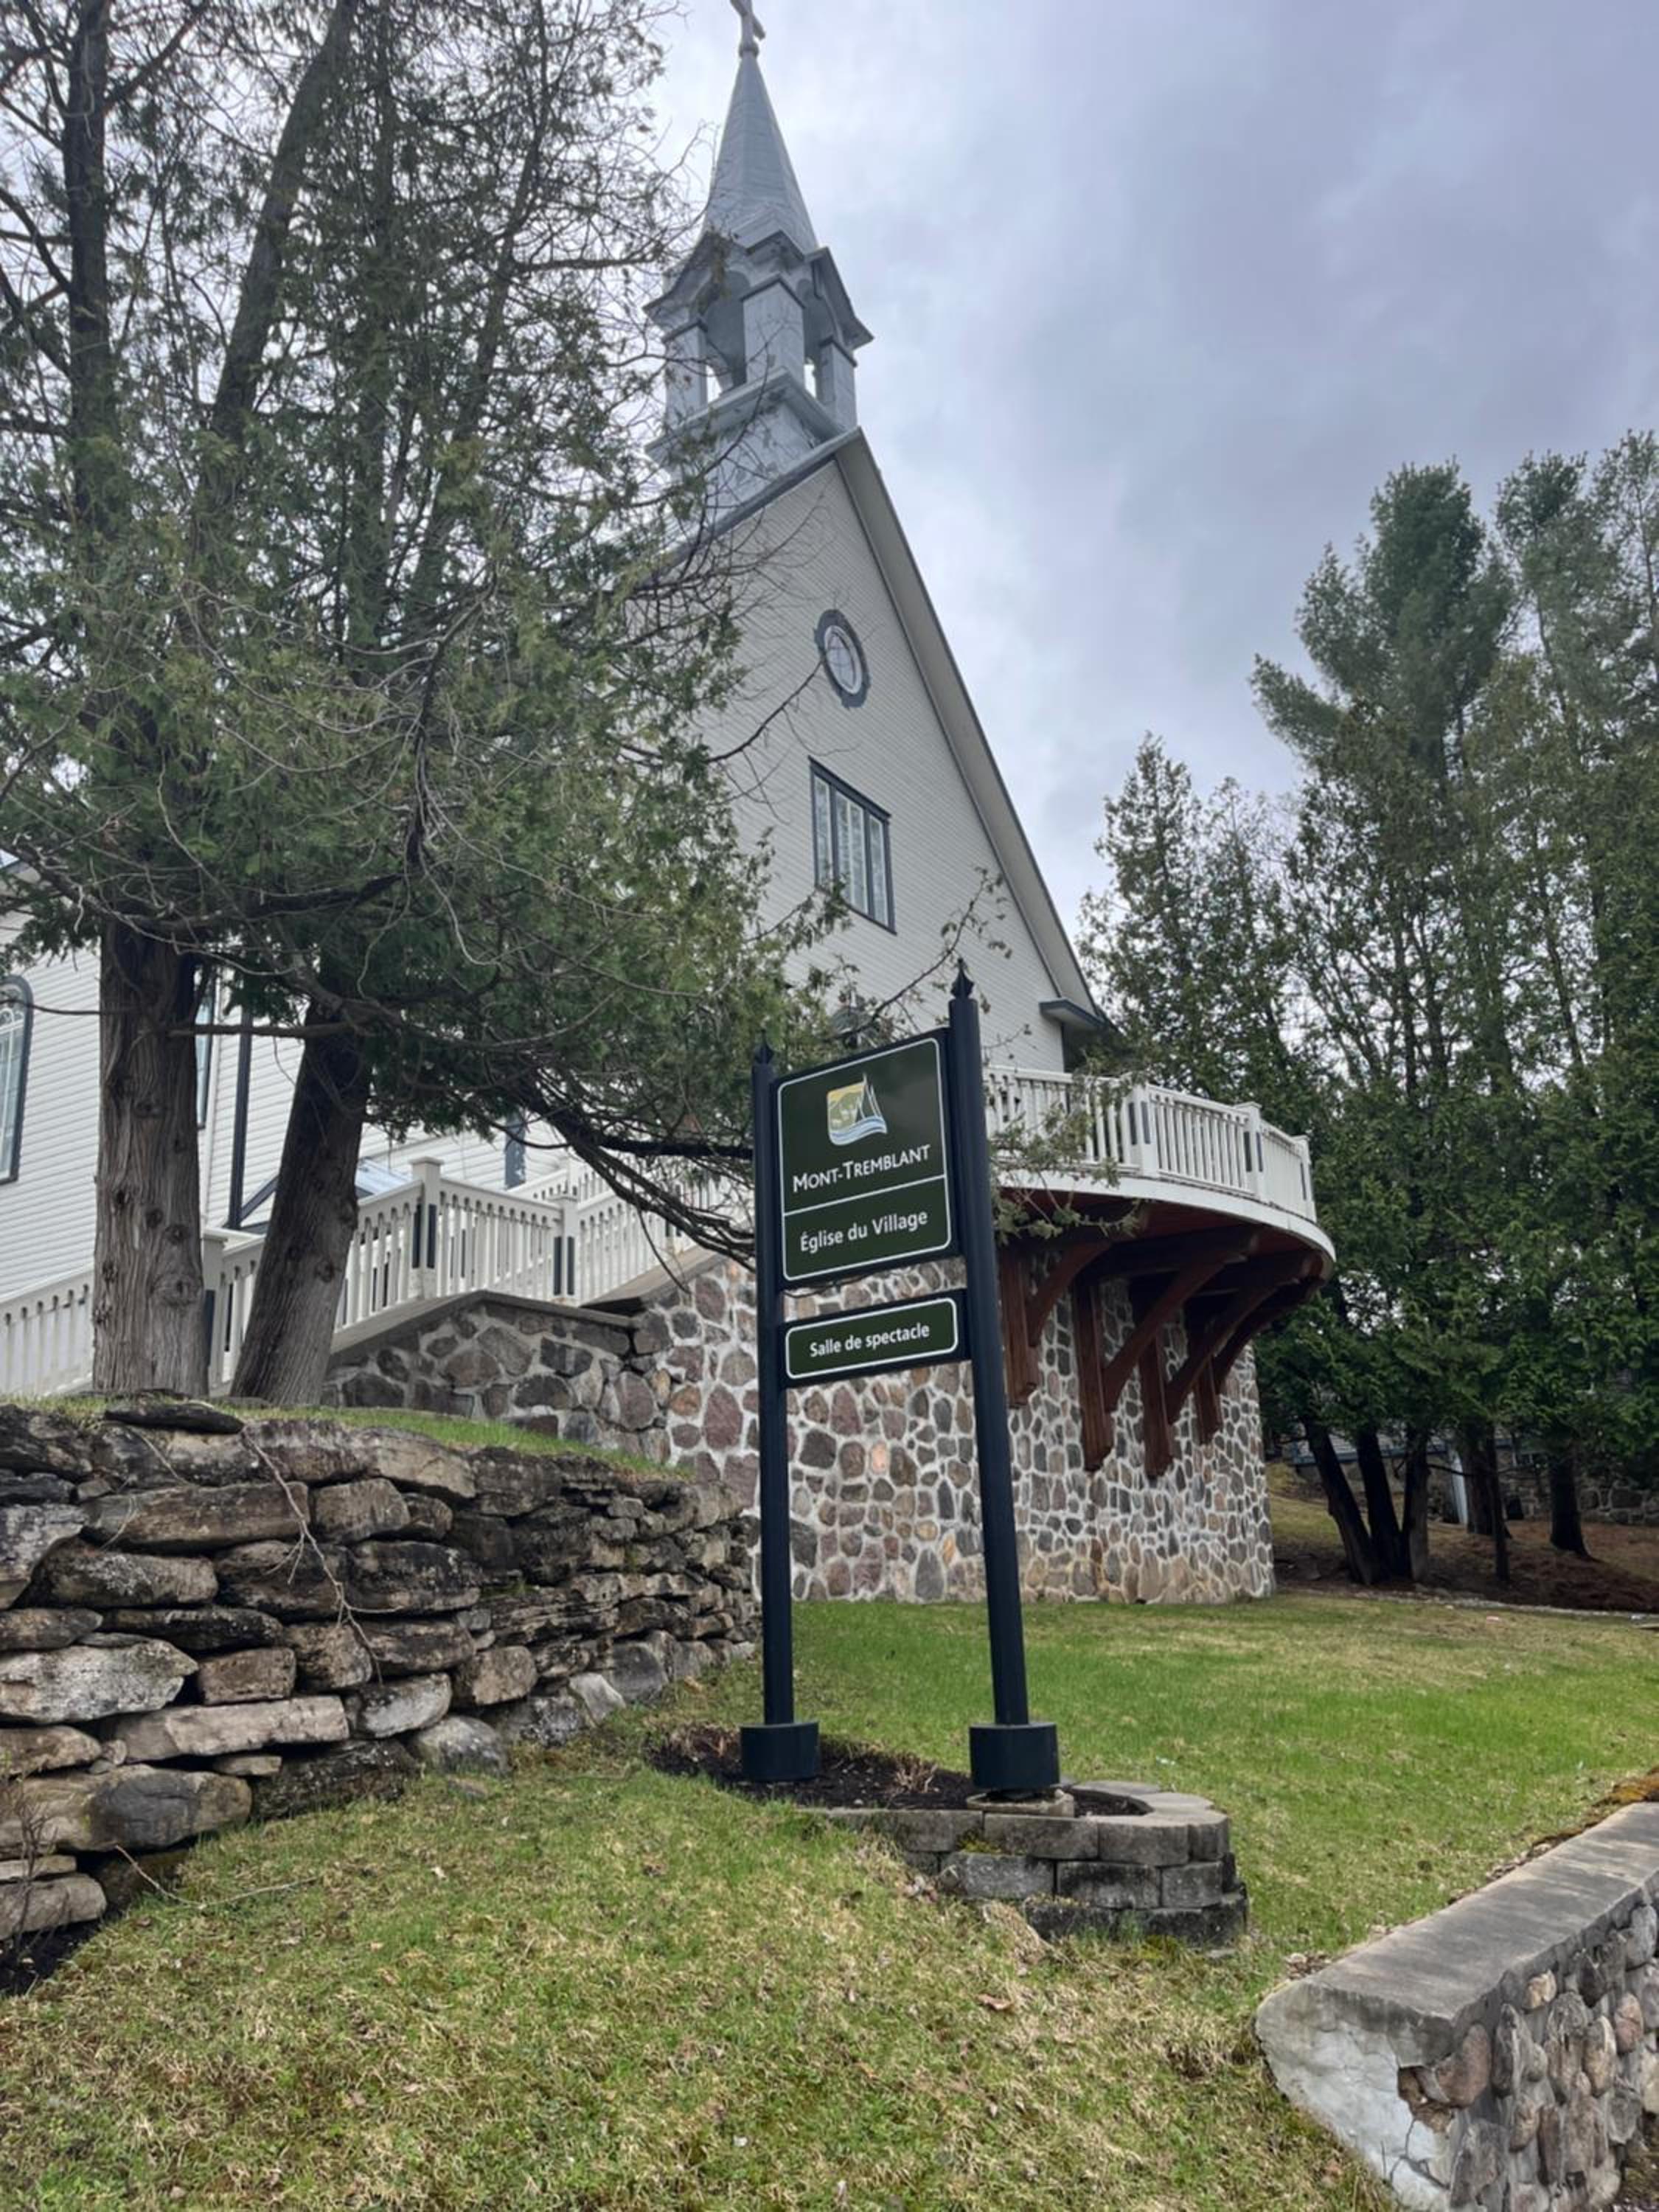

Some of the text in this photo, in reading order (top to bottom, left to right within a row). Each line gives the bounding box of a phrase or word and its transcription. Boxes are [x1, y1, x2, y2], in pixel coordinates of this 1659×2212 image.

[793, 1144, 931, 1193] MONT-TREMBLANT
[800, 1211, 928, 1254] Église du Village
[810, 1322, 931, 1357] Salle de spectacle
